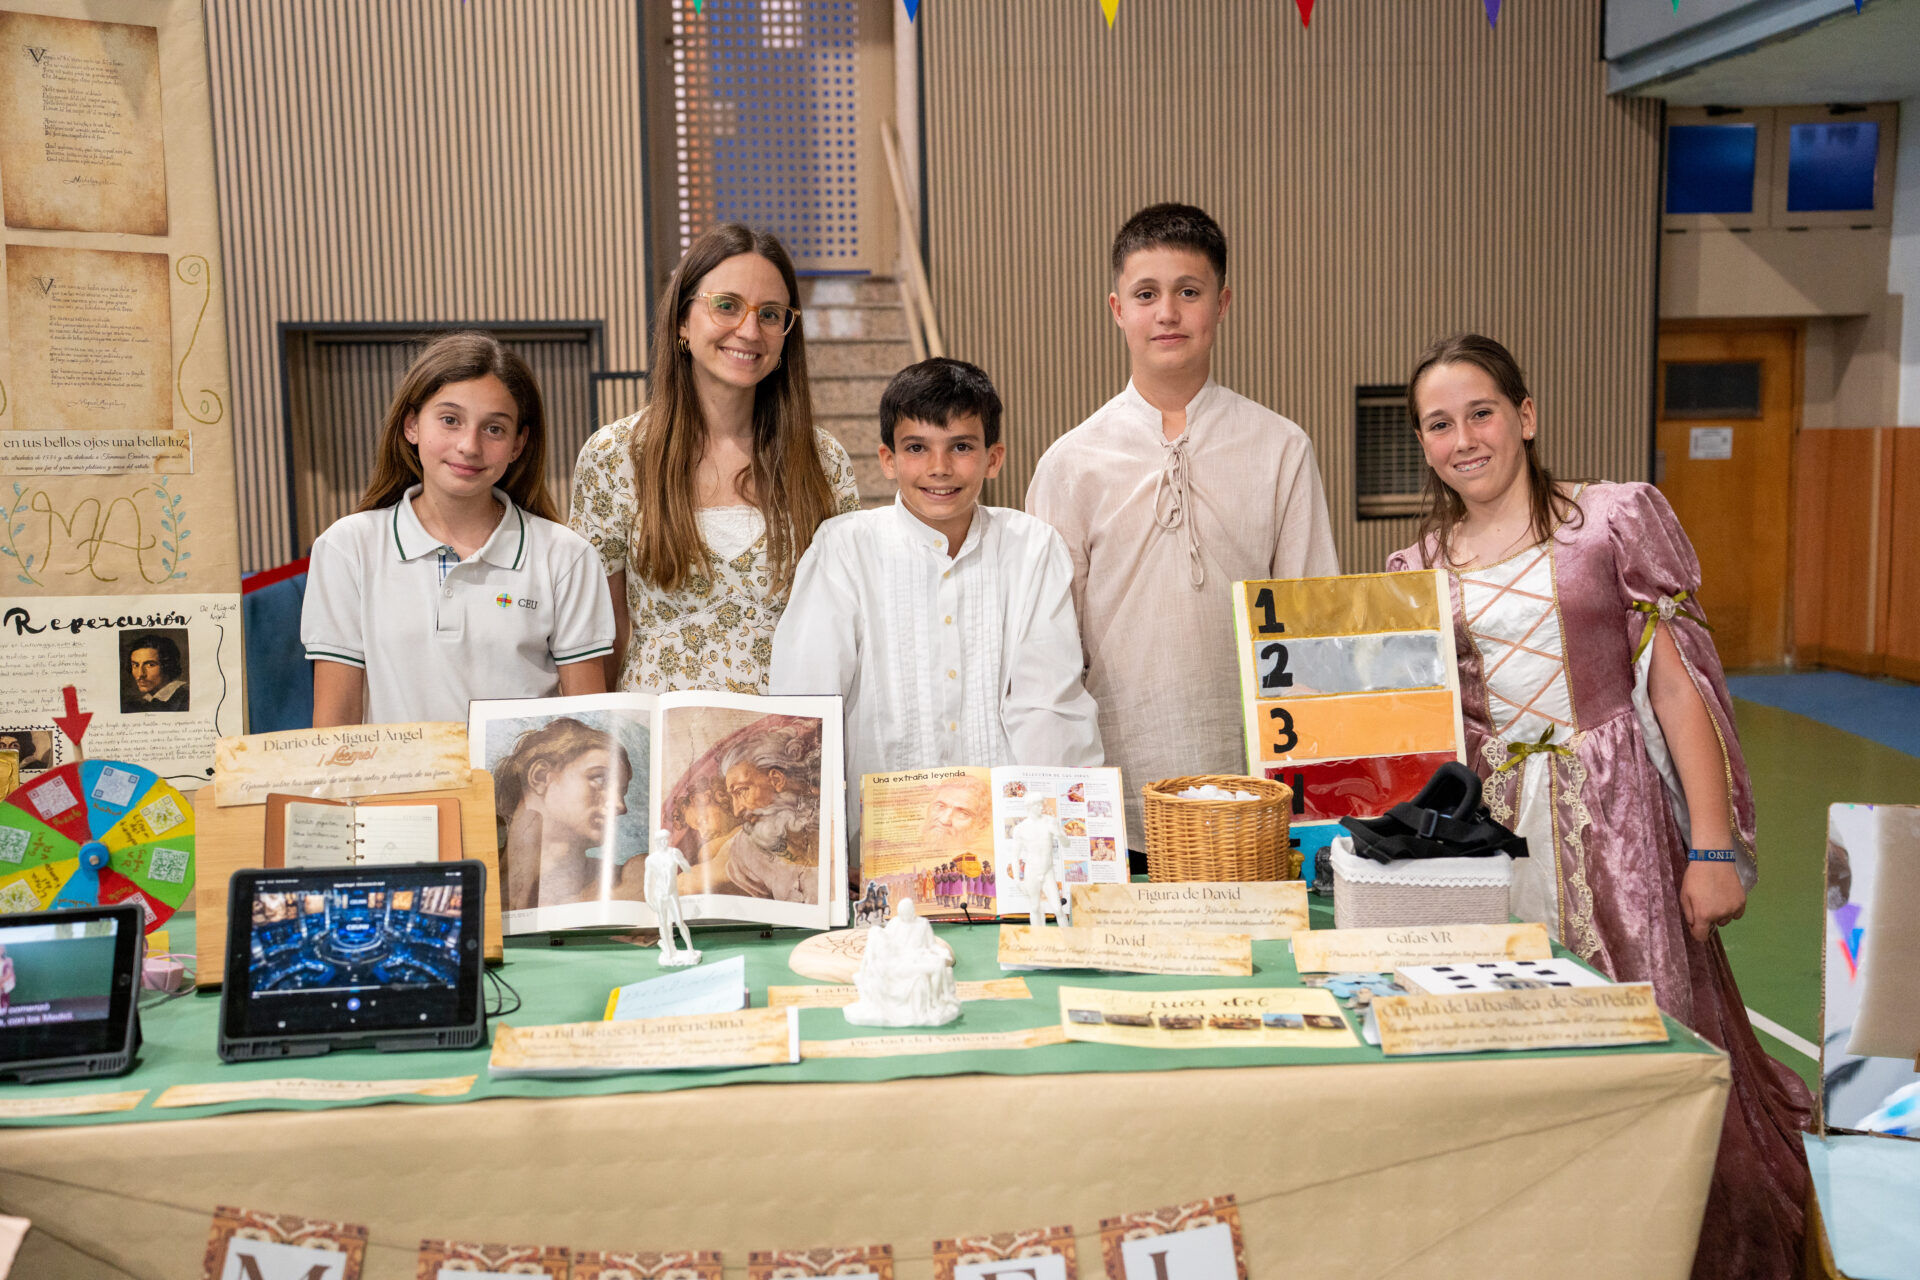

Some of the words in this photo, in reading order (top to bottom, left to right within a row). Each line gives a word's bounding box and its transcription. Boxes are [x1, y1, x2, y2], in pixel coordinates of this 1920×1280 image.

[3, 439, 20, 448] en
[22, 438, 42, 448] tus
[44, 437, 81, 448] bellos
[83, 438, 109, 450] ojos
[112, 438, 135, 448] una
[137, 436, 166, 447] bella
[167, 436, 185, 447] luz
[518, 599, 538, 610] CEU
[1255, 588, 1285, 634] 1
[3, 606, 192, 636] Repercusión
[1260, 642, 1294, 689] 2
[264, 737, 309, 752] Diario
[311, 735, 329, 747] de
[333, 730, 380, 748] Miguel
[383, 727, 423, 743] Ángel
[1270, 707, 1299, 754] 3
[892, 773, 929, 783] extraña
[931, 769, 966, 780] leyenda
[1138, 888, 1180, 904] Figura
[1182, 887, 1200, 900] de
[1202, 886, 1241, 900] David
[1104, 933, 1146, 948] David
[1387, 931, 1429, 944] Gafas
[1431, 930, 1454, 944] VR
[1382, 1000, 1440, 1021] Cúpula
[1443, 999, 1462, 1014] de
[1464, 998, 1480, 1013] la
[1481, 995, 1541, 1012] basílica
[1548, 993, 1568, 1008] de
[1570, 993, 1600, 1008] San
[1601, 991, 1648, 1008] Pedro
[641, 1018, 745, 1035] Laurenciana
